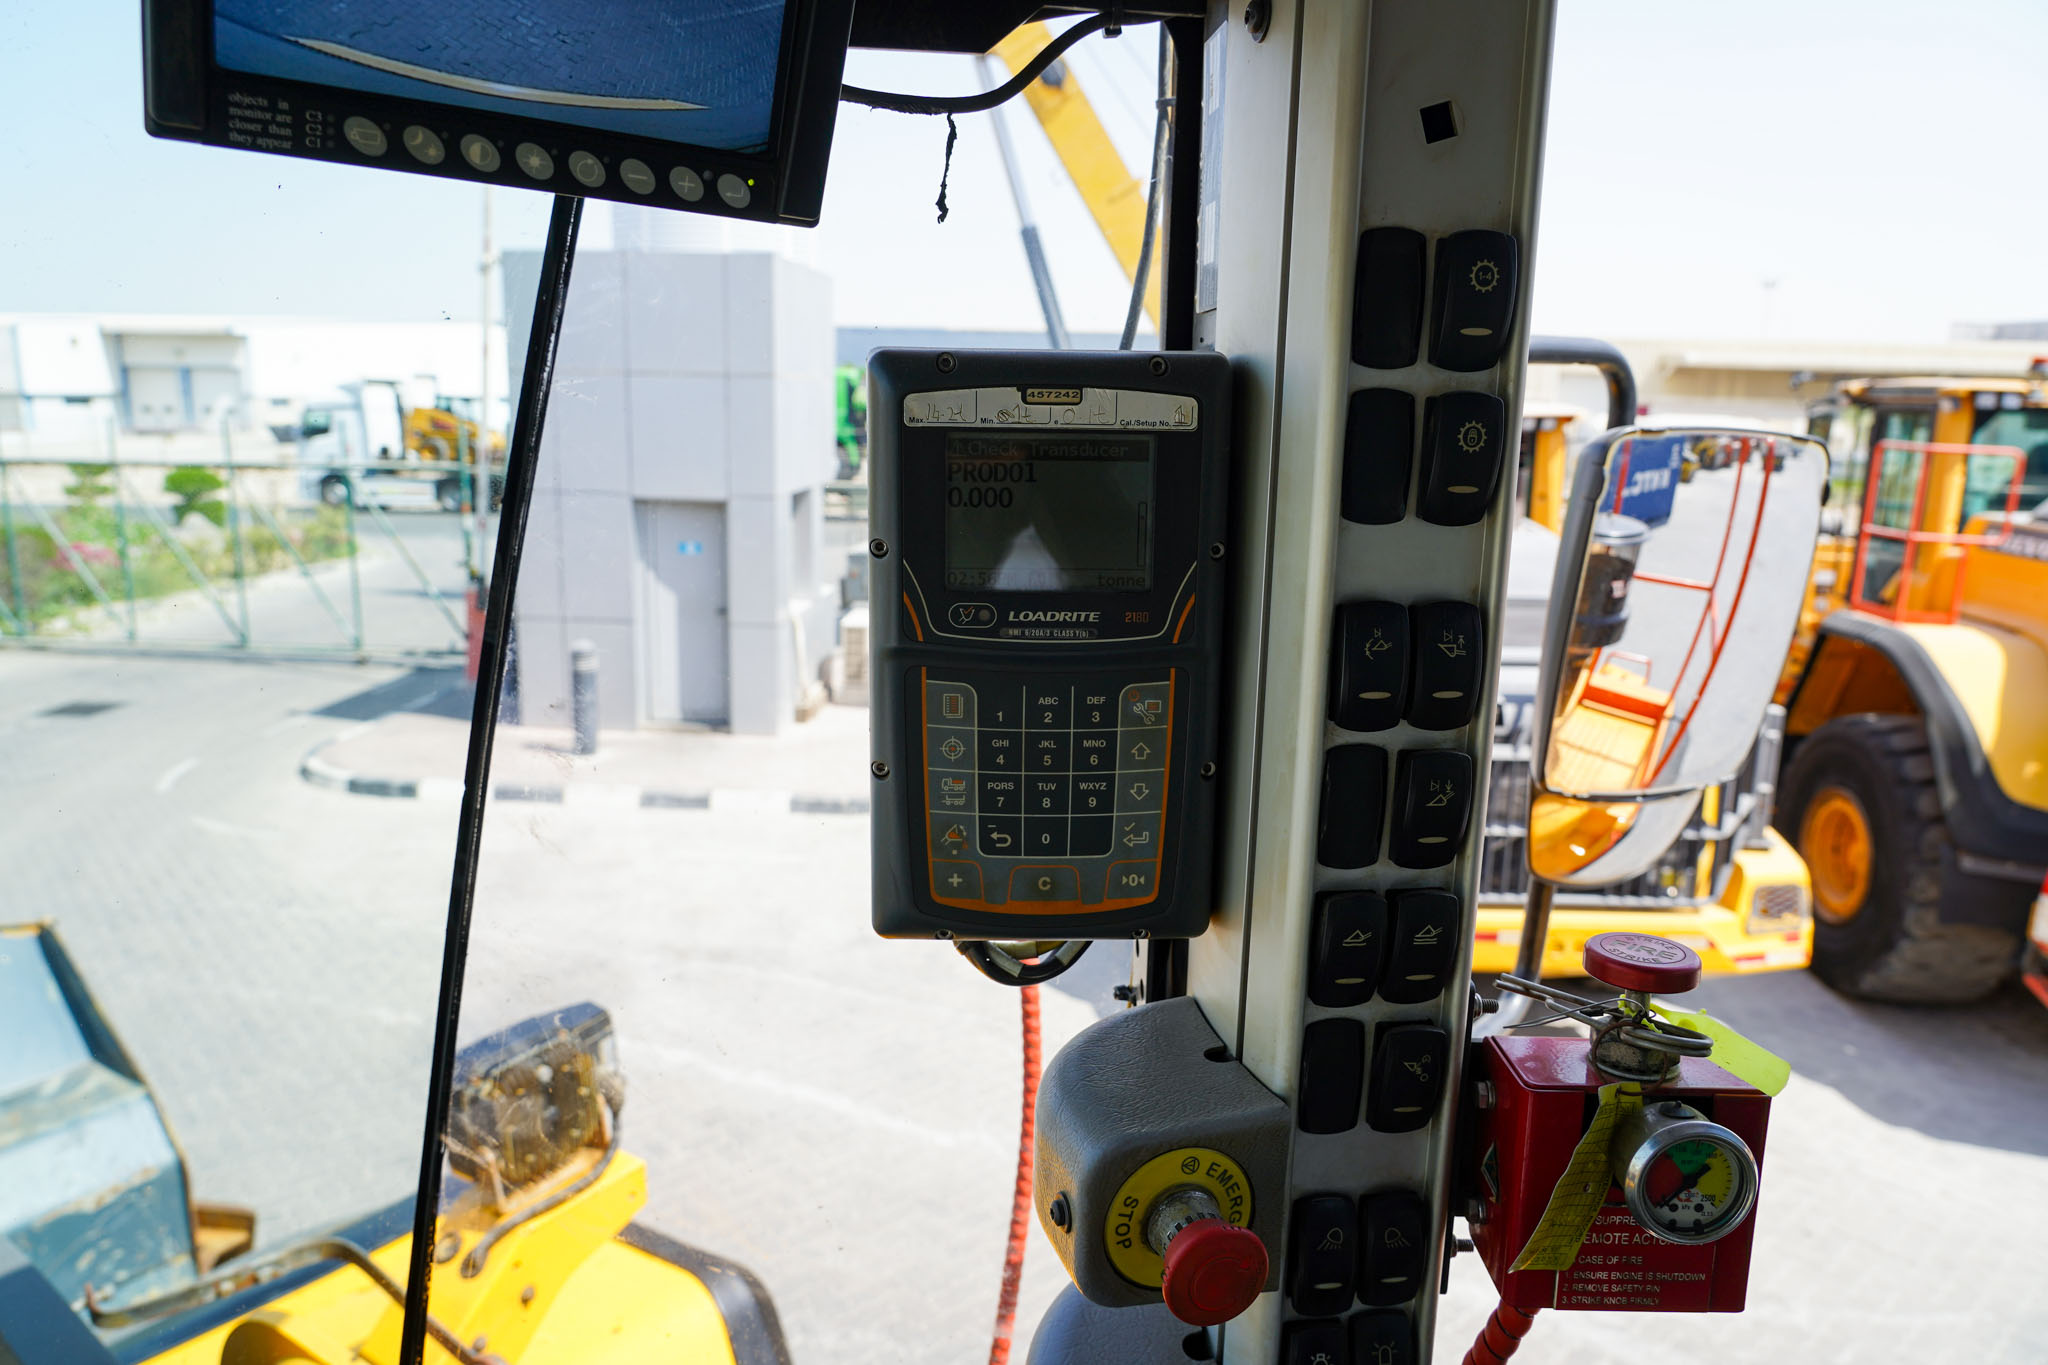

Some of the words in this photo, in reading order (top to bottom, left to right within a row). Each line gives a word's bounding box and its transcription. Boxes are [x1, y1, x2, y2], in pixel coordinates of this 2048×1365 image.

[228, 92, 269, 107] objects
[277, 99, 289, 110] in
[228, 106, 273, 120] monitor
[275, 113, 293, 124] are
[305, 110, 322, 121] C3
[228, 118, 263, 132] closer
[268, 124, 292, 136] than
[305, 122, 322, 135] C2
[229, 130, 254, 146] they
[255, 137, 293, 149] appear
[305, 136, 320, 148] C1
[1027, 391, 1080, 399] 457242
[909, 416, 926, 424] Max.
[980, 416, 996, 425] Min.
[1119, 418, 1157, 428] Cal./Setup
[967, 441, 1017, 457] Check
[1030, 442, 1129, 457] Transducer
[948, 462, 1038, 482] PROD01
[948, 487, 1013, 508] 0.000
[1097, 574, 1146, 586] tonne
[1008, 610, 1101, 622] LOADRITE
[1038, 696, 1059, 705] ABC
[1087, 696, 1106, 705] DEF
[996, 711, 1003, 722] 1
[1043, 711, 1053, 723] 2
[1091, 711, 1100, 722] 3
[991, 739, 1009, 748] GHI
[1038, 739, 1057, 748] JKL
[1083, 739, 1106, 748] MNO
[995, 754, 1004, 765] 4
[1043, 754, 1052, 765] 5
[1090, 754, 1098, 765] 6
[987, 782, 1014, 791] PQRS
[1037, 782, 1057, 790] TUV
[1079, 782, 1107, 790] WXYZ
[996, 796, 1005, 807] 7
[1042, 797, 1051, 808] 8
[1088, 796, 1097, 807] 9
[1041, 833, 1050, 844] 0
[1038, 876, 1051, 890] C
[1610, 939, 1679, 960] FIRE
[1608, 948, 1663, 964] STRIKE
[1205, 1162, 1244, 1224] EMERG
[1701, 1194, 1717, 1202] 2500
[1115, 1196, 1139, 1249] STOP
[1595, 1215, 1640, 1226] SUPPRE
[1582, 1232, 1630, 1245] EMOTE
[1578, 1255, 1603, 1265] CASE
[1606, 1255, 1620, 1265] OF
[1622, 1256, 1643, 1265] FIRE
[1573, 1271, 1608, 1280] ENSURE
[1610, 1272, 1643, 1280] ENGINE
[1645, 1272, 1653, 1280] IS
[1656, 1272, 1706, 1281] SHUTDOWN
[1572, 1284, 1609, 1292] REMOVE
[1611, 1284, 1643, 1292] SAFETY
[1646, 1284, 1660, 1293] PIN
[1562, 1296, 1569, 1304] 3.
[1571, 1295, 1601, 1304] STRIKE
[1603, 1296, 1628, 1305] KNOB
[1630, 1296, 1660, 1305] FIRMLY
